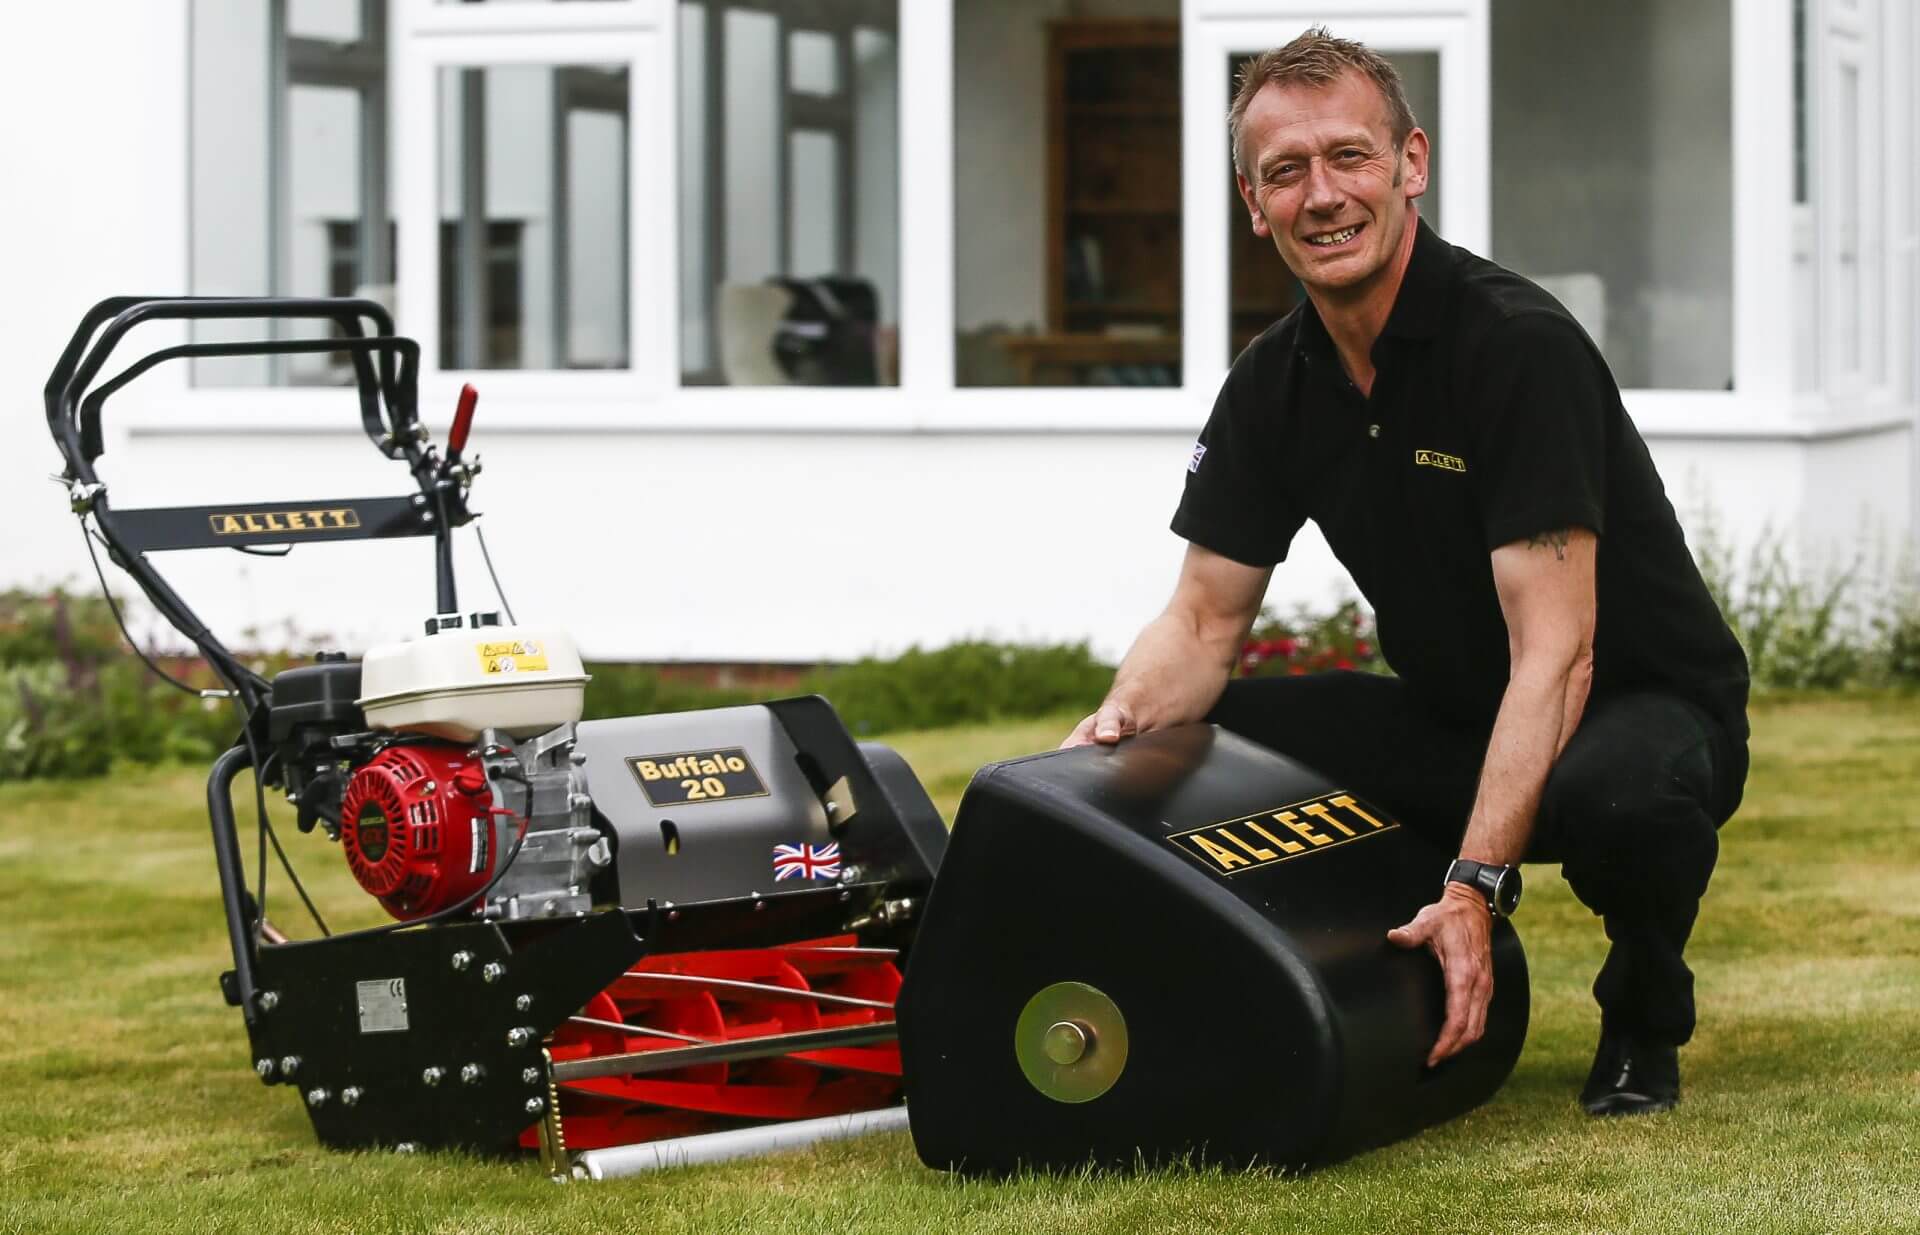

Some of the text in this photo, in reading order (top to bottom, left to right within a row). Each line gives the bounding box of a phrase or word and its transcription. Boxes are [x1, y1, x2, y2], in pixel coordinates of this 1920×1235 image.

[1420, 453, 1462, 469] ALLETT
[223, 512, 346, 533] ALLETT
[636, 754, 745, 780] Buffalo
[680, 777, 725, 799] 20
[1189, 795, 1383, 869] ALLETT
